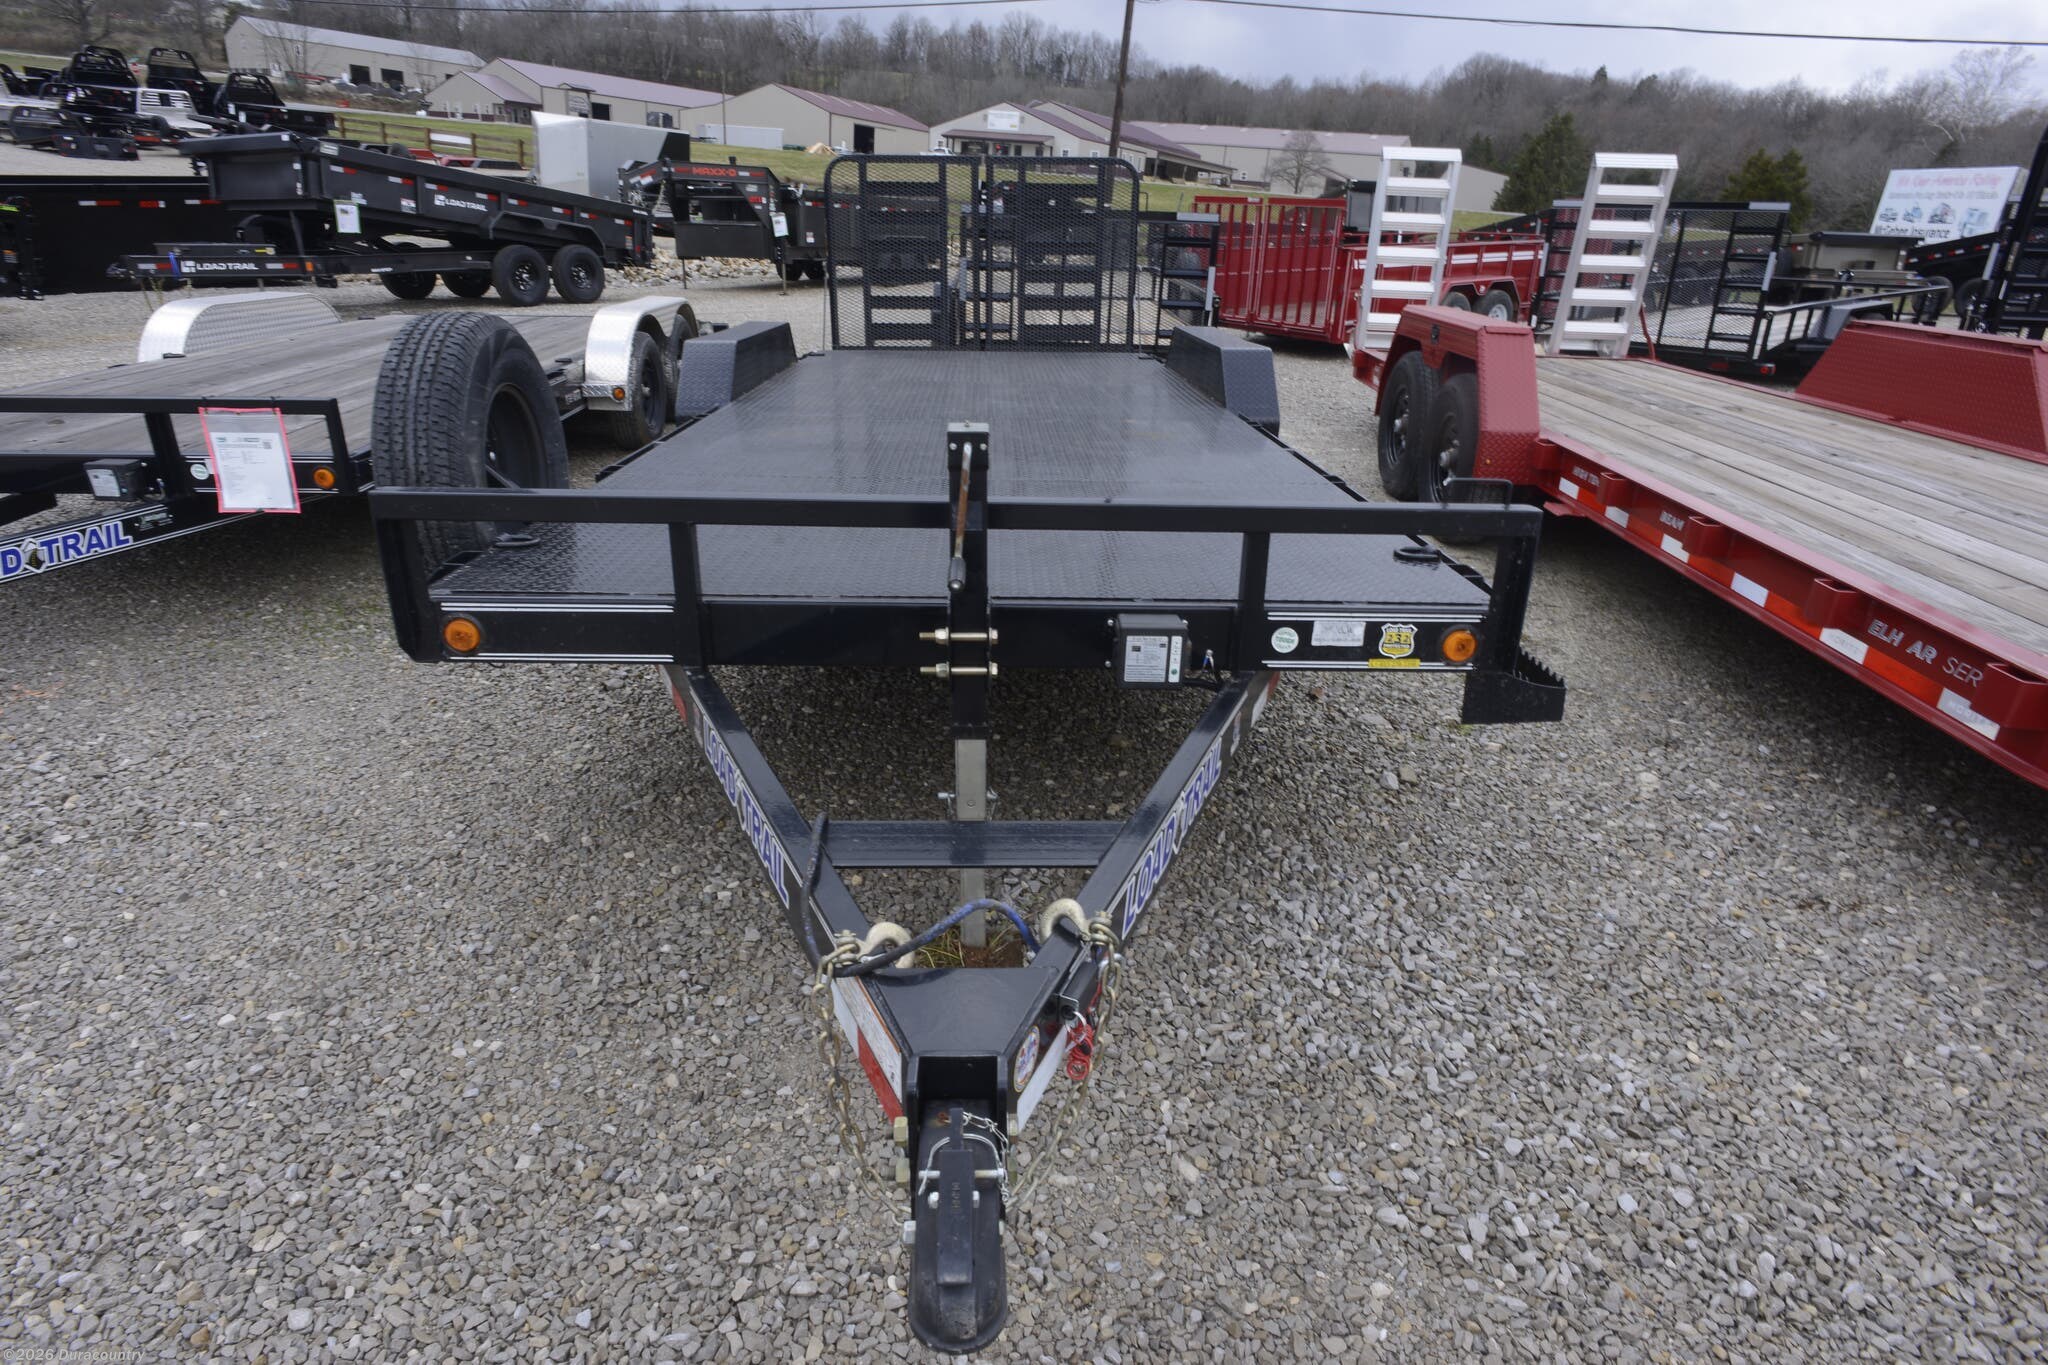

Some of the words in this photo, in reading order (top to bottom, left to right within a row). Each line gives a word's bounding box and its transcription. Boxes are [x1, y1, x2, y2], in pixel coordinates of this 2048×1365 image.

[39, 521, 132, 565] TRAIL
[1942, 657, 1984, 688] SER
[703, 714, 737, 807] LOAD
[741, 780, 790, 909] TRAIL
[1121, 811, 1177, 940] LOAD
[1180, 736, 1223, 839] TRAIL
